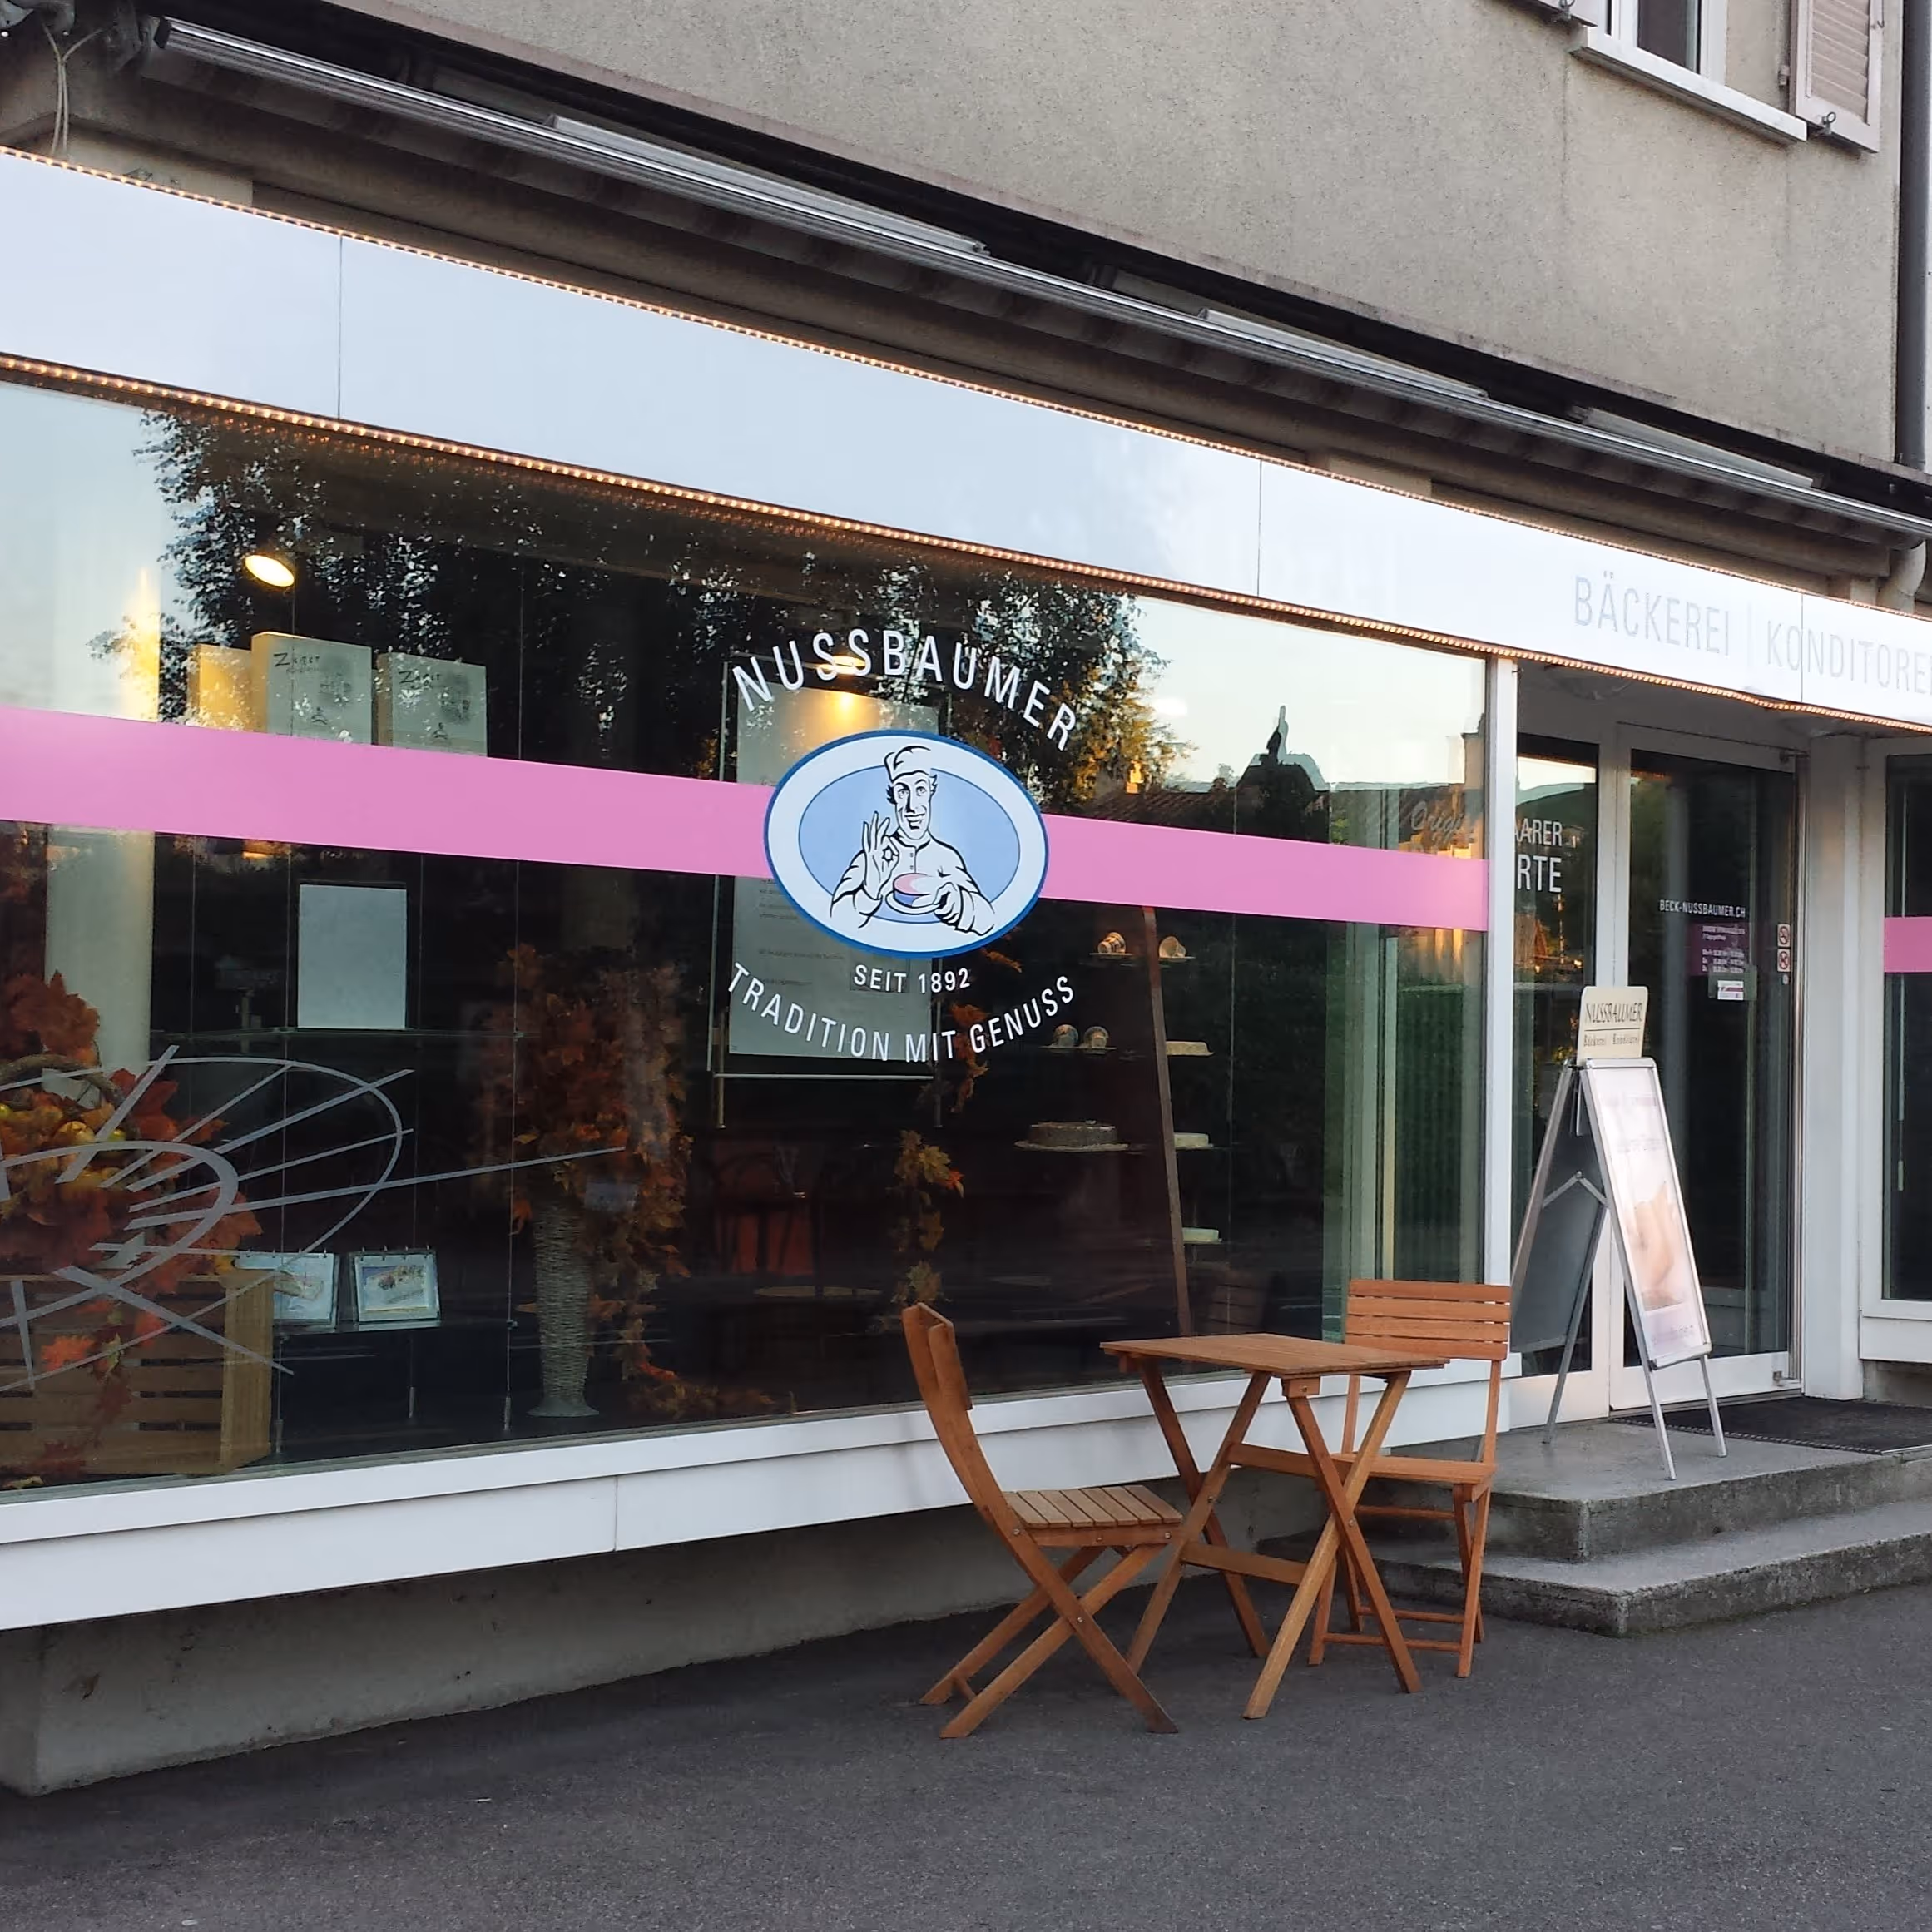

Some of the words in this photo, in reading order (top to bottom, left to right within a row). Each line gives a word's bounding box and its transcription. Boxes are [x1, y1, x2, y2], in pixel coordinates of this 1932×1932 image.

[1574, 570, 1730, 656] BÄCKEREI
[732, 628, 1076, 751] NUSSBAUMER
[1517, 854, 1563, 893] RTE
[1659, 899, 1746, 918] BECK-NUSSBAUMER.CH
[853, 964, 907, 993] SEIT
[918, 968, 971, 993] 1892
[727, 962, 890, 1063] TRADITION
[905, 1029, 957, 1063] MIT
[970, 975, 1075, 1053] GENUSS
[1584, 1003, 1642, 1023] NUSSBAUMER
